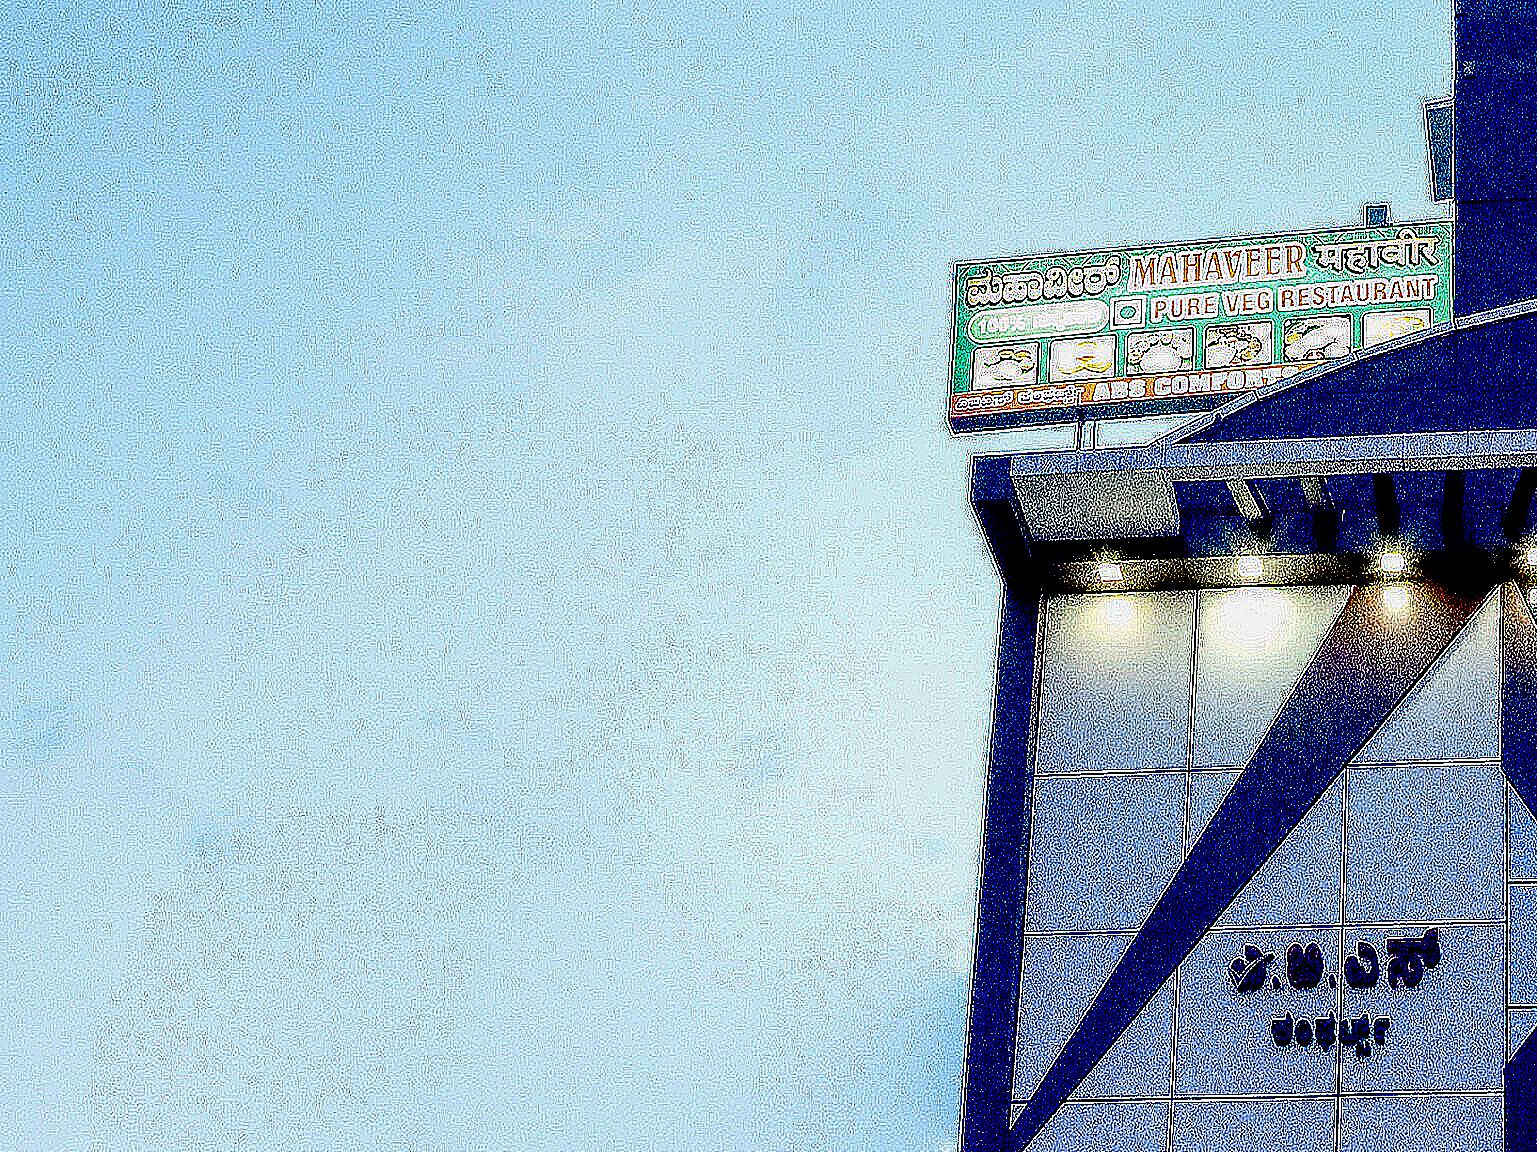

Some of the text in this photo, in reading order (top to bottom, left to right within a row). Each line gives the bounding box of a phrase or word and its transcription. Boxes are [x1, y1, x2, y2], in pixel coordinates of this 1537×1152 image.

[1131, 243, 1306, 289] MAHAVEER
[1314, 228, 1440, 274] महावीर
[1153, 276, 1437, 321] PURE VEG RESTAURANT
